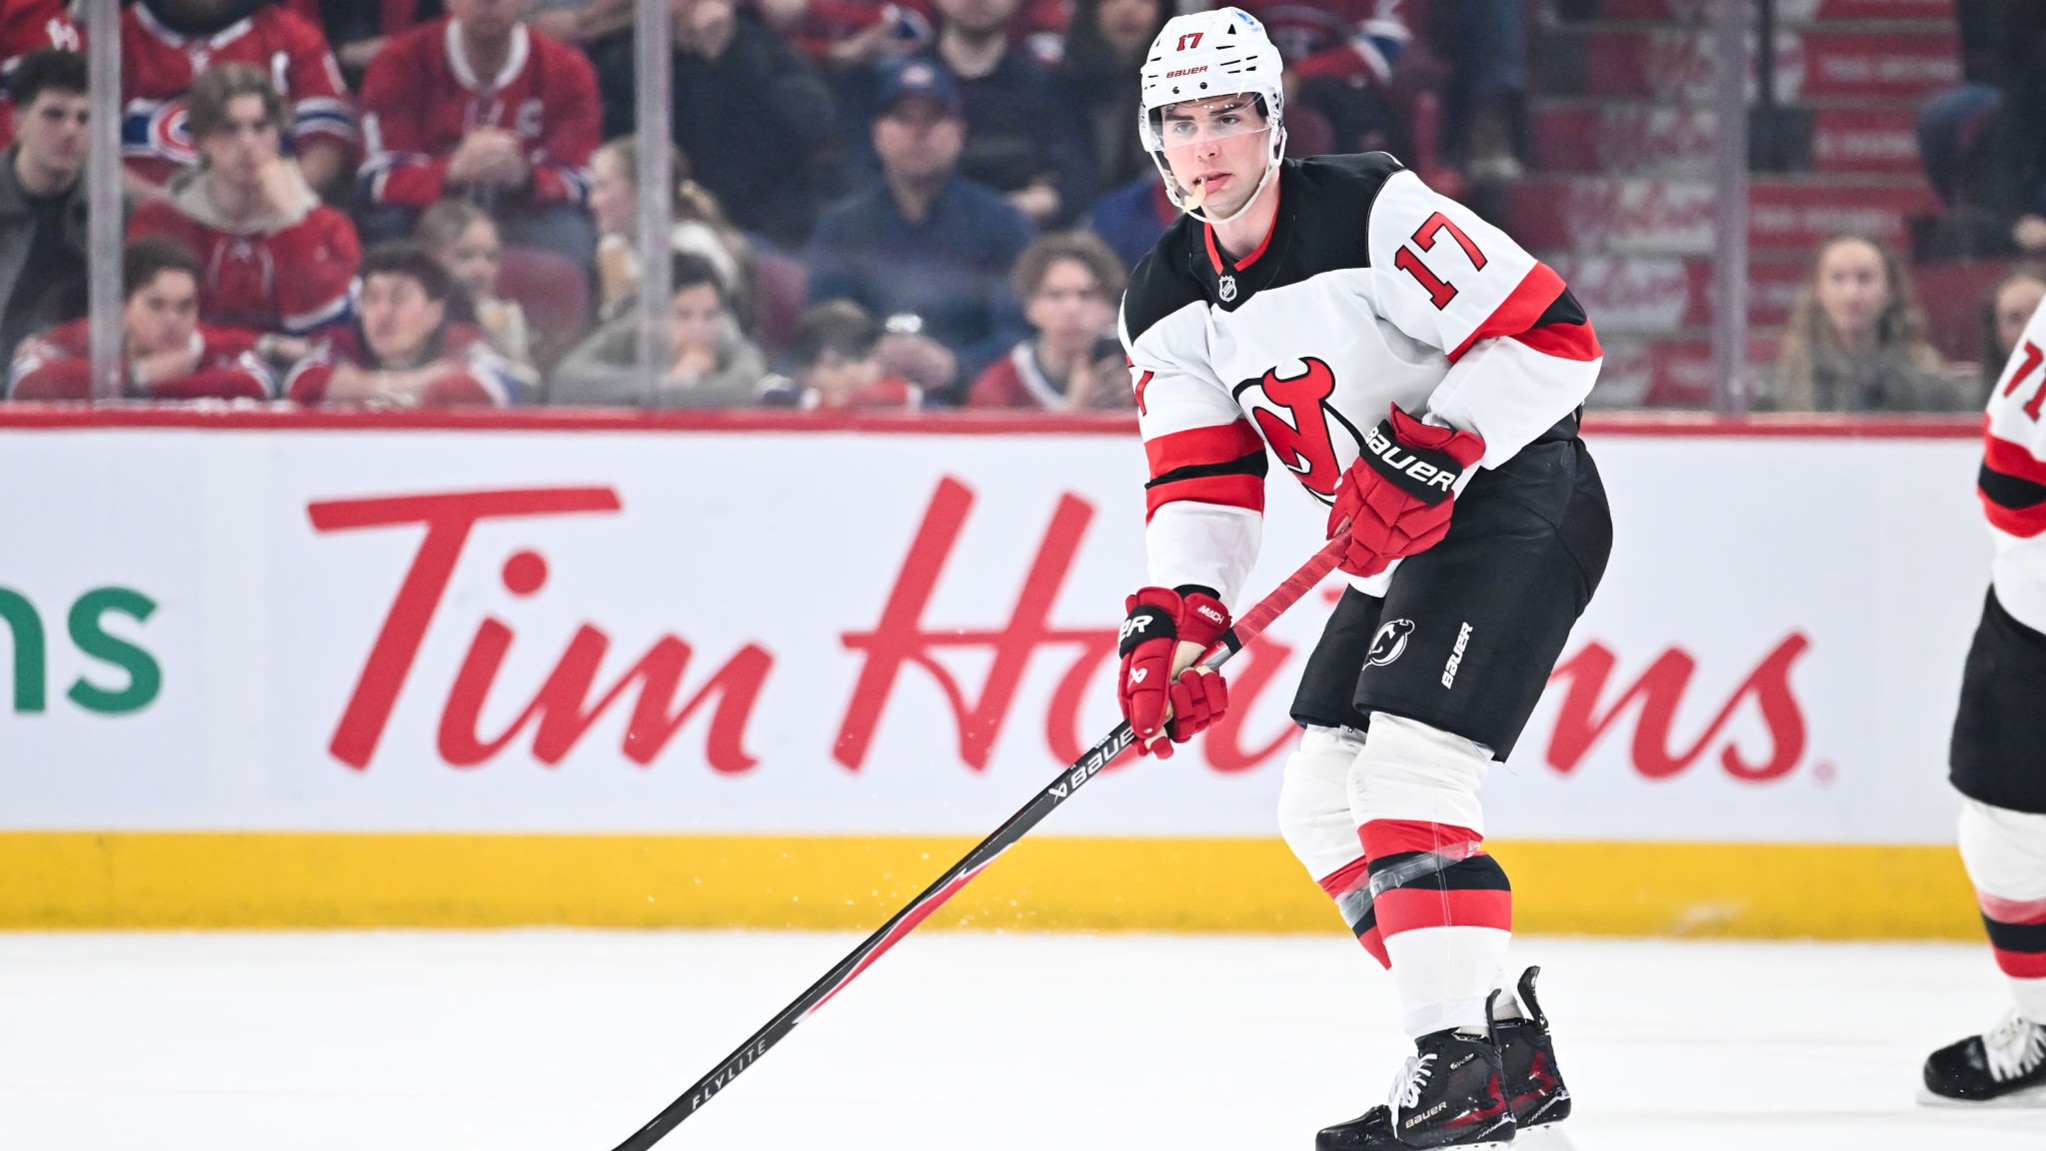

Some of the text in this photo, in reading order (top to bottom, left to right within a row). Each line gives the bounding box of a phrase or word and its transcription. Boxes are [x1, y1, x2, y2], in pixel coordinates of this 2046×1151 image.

[1166, 65, 1209, 79] BAUER
[1176, 32, 1204, 51] 17
[1394, 211, 1488, 311] 17
[306, 484, 776, 775] Tim
[1197, 604, 1225, 625] MACH
[1441, 621, 1474, 690] BAUER
[1070, 725, 1137, 790] BAUE
[692, 1039, 766, 1110] FLYLITE
[1405, 1101, 1447, 1129] BAUER
